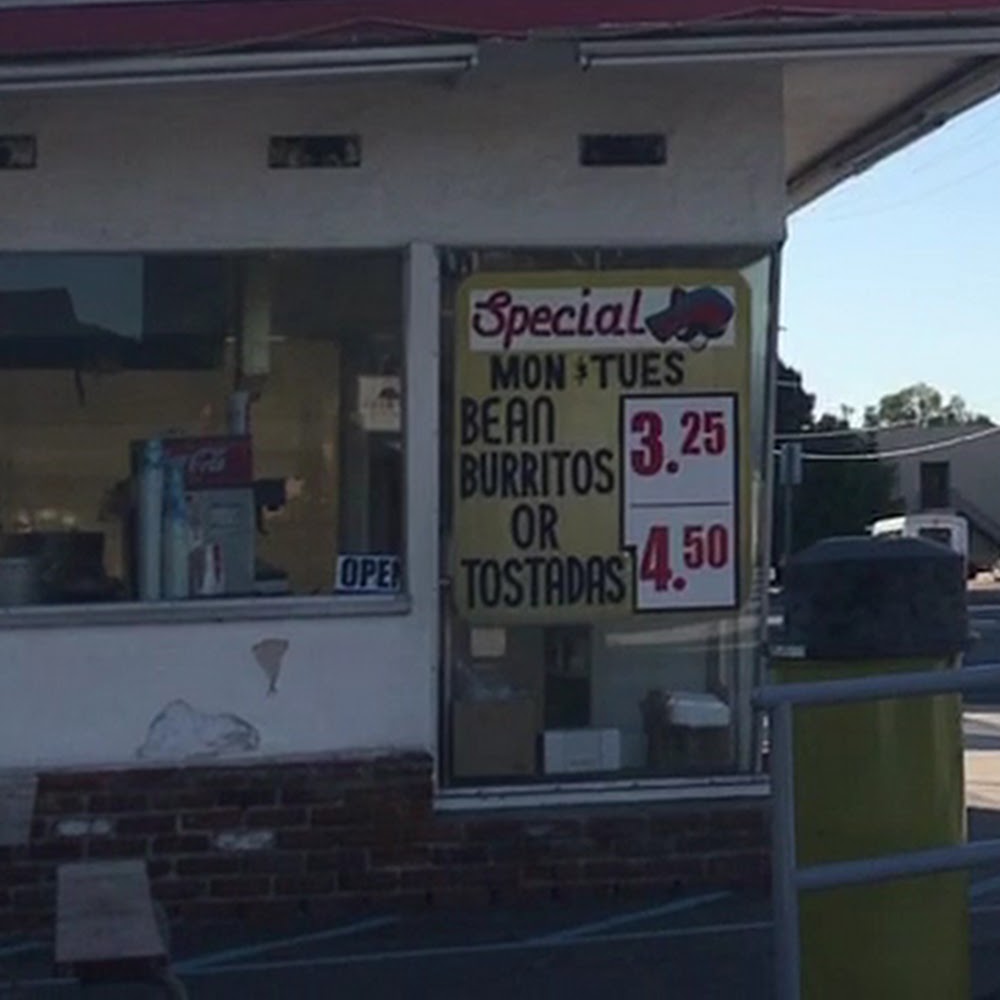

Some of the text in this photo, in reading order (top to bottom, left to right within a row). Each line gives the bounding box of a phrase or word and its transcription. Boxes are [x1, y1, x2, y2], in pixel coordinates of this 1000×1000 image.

[472, 287, 646, 349] Special
[490, 354, 566, 389] MON
[590, 352, 686, 388] TUES
[460, 396, 555, 446] BEAN
[630, 411, 727, 477] 3.25
[460, 448, 615, 499] BURRITOS
[510, 503, 560, 550] OR
[460, 555, 628, 608] TOSTADAS
[640, 523, 729, 592] 4.50
